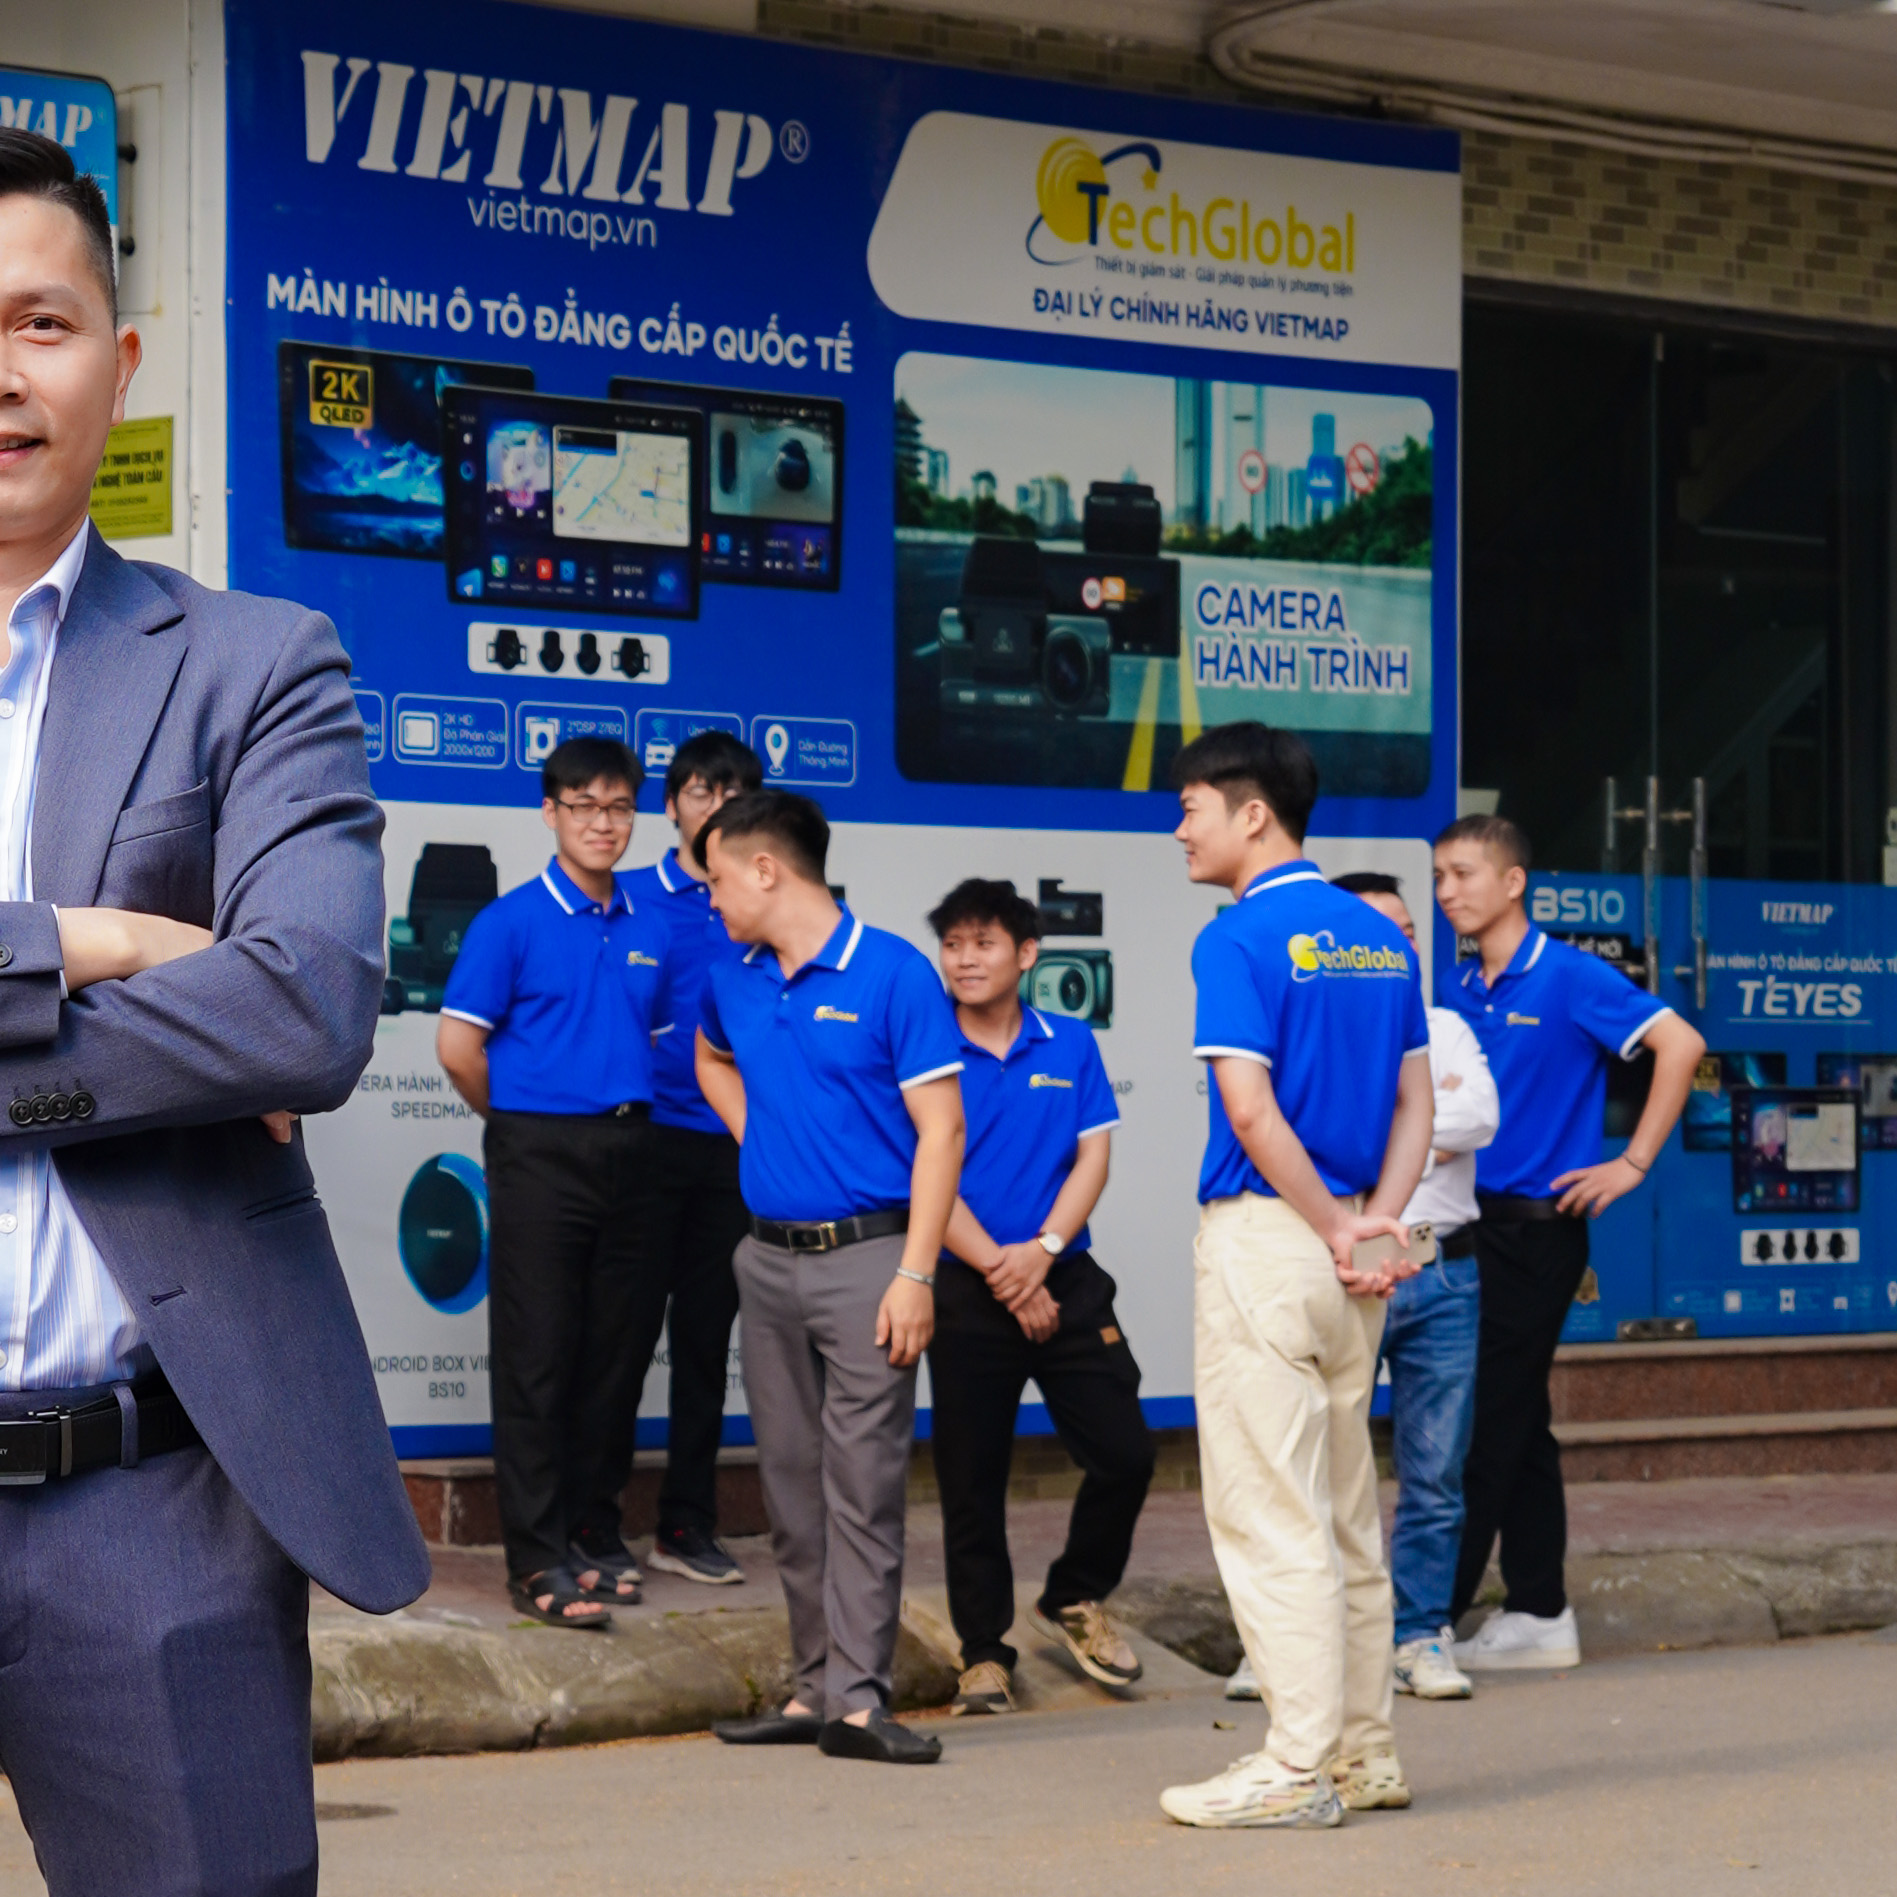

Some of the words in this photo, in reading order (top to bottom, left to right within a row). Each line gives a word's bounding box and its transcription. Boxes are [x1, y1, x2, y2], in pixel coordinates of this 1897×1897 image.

[467, 190, 657, 251] vietmap.vn
[1077, 181, 1354, 273] TechGlobal
[266, 267, 347, 317] MÀN
[355, 276, 439, 330] HÌNH
[446, 286, 473, 333] Ô
[480, 292, 528, 339] TÔ
[533, 287, 631, 350] ĐẲNG
[638, 302, 706, 357] CẤP
[712, 313, 807, 369] QUỐC
[814, 320, 854, 375] TẾ
[1033, 288, 1072, 321] ĐẠI
[1079, 286, 1103, 317] LÝ
[1110, 291, 1179, 326] CHÍNH
[1187, 299, 1249, 333] HÃNG
[1255, 310, 1349, 342] VIETMAP
[320, 369, 361, 402] 2K
[319, 406, 364, 425] QLED
[1196, 582, 1347, 634] CAMERA
[1196, 628, 1298, 689] HÀNH
[1305, 635, 1411, 694] TRÌNH
[1533, 887, 1625, 924] BS10
[1762, 901, 1833, 924] VIETMAP
[1307, 944, 1409, 971] TechGlobal
[397, 1070, 441, 1092] HÀNH
[432, 1355, 464, 1371] BOX
[429, 1382, 465, 1399] BS10
